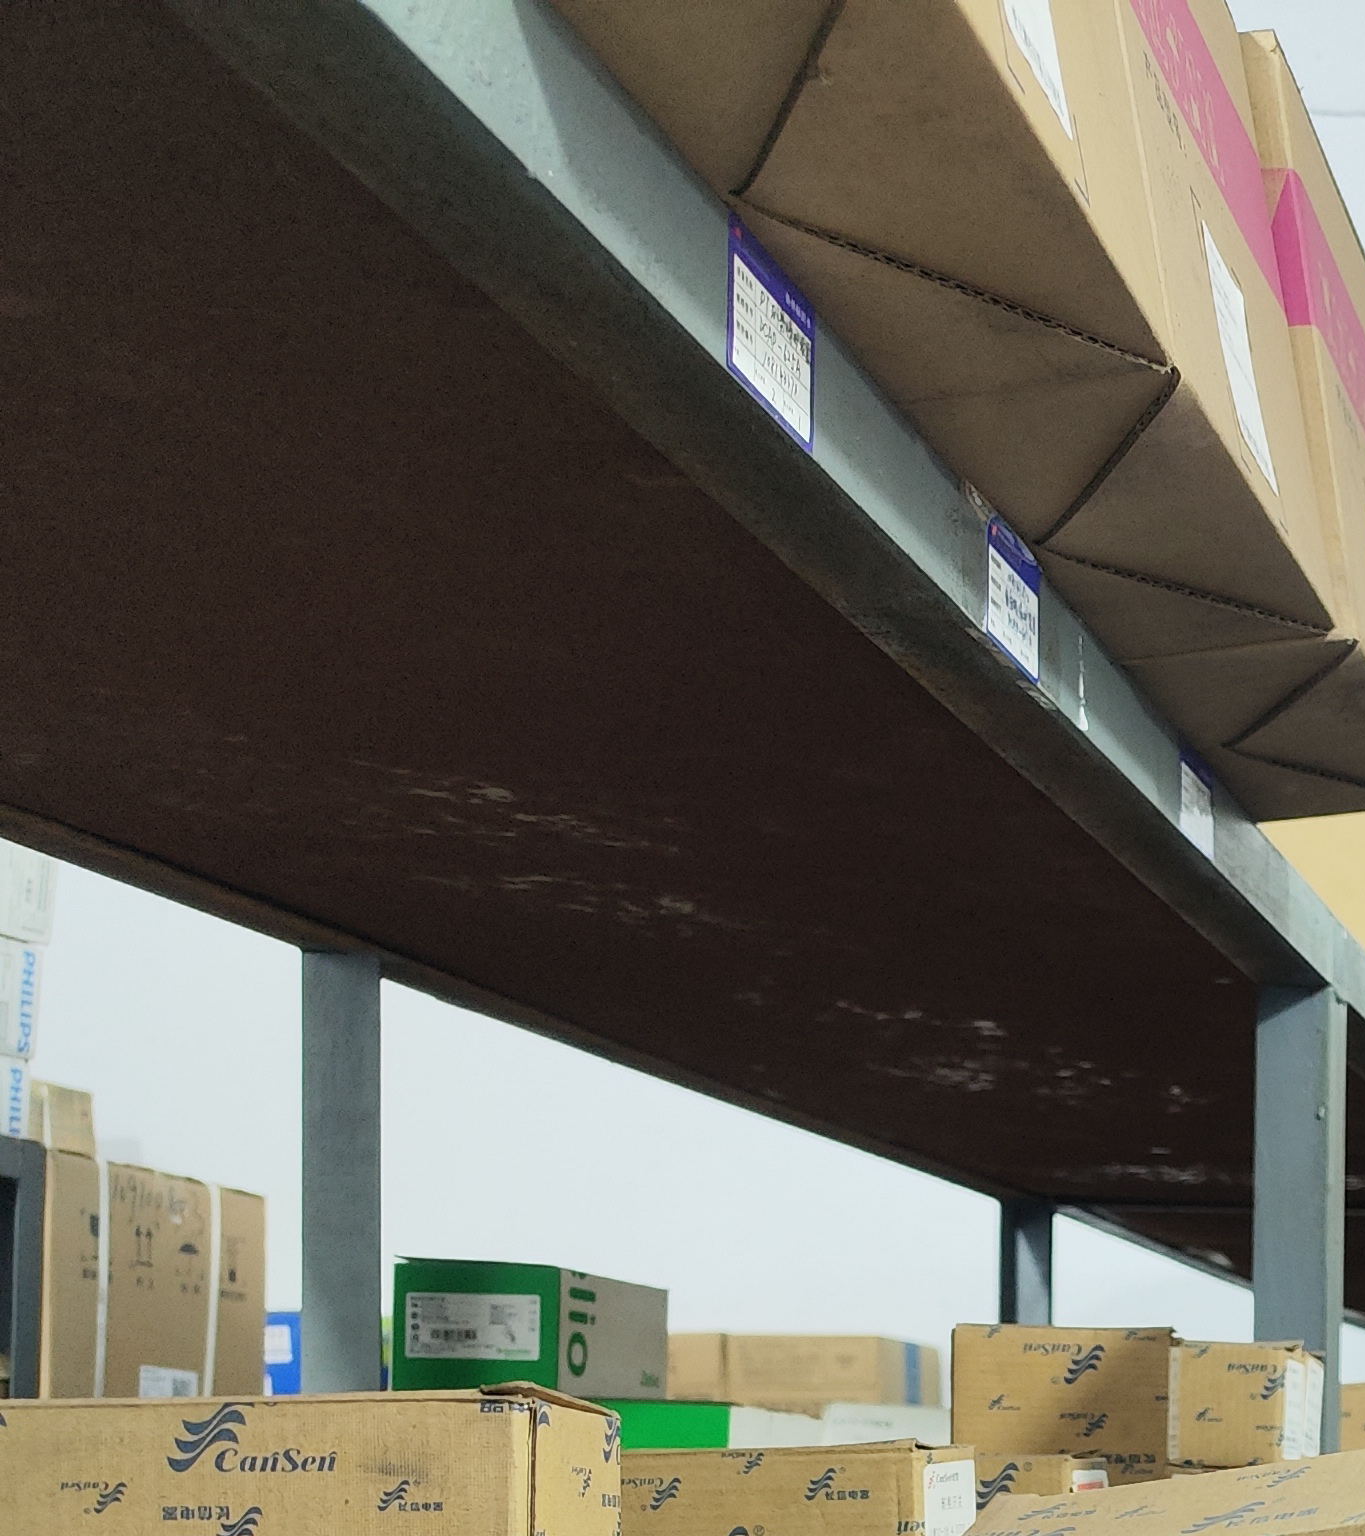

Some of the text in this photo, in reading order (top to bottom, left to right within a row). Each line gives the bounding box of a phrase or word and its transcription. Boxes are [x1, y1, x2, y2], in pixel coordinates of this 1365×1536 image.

[17, 950, 36, 1054] PHILIPS
[214, 1448, 337, 1473] CanSen
[162, 1505, 230, 1521] 长信电器
